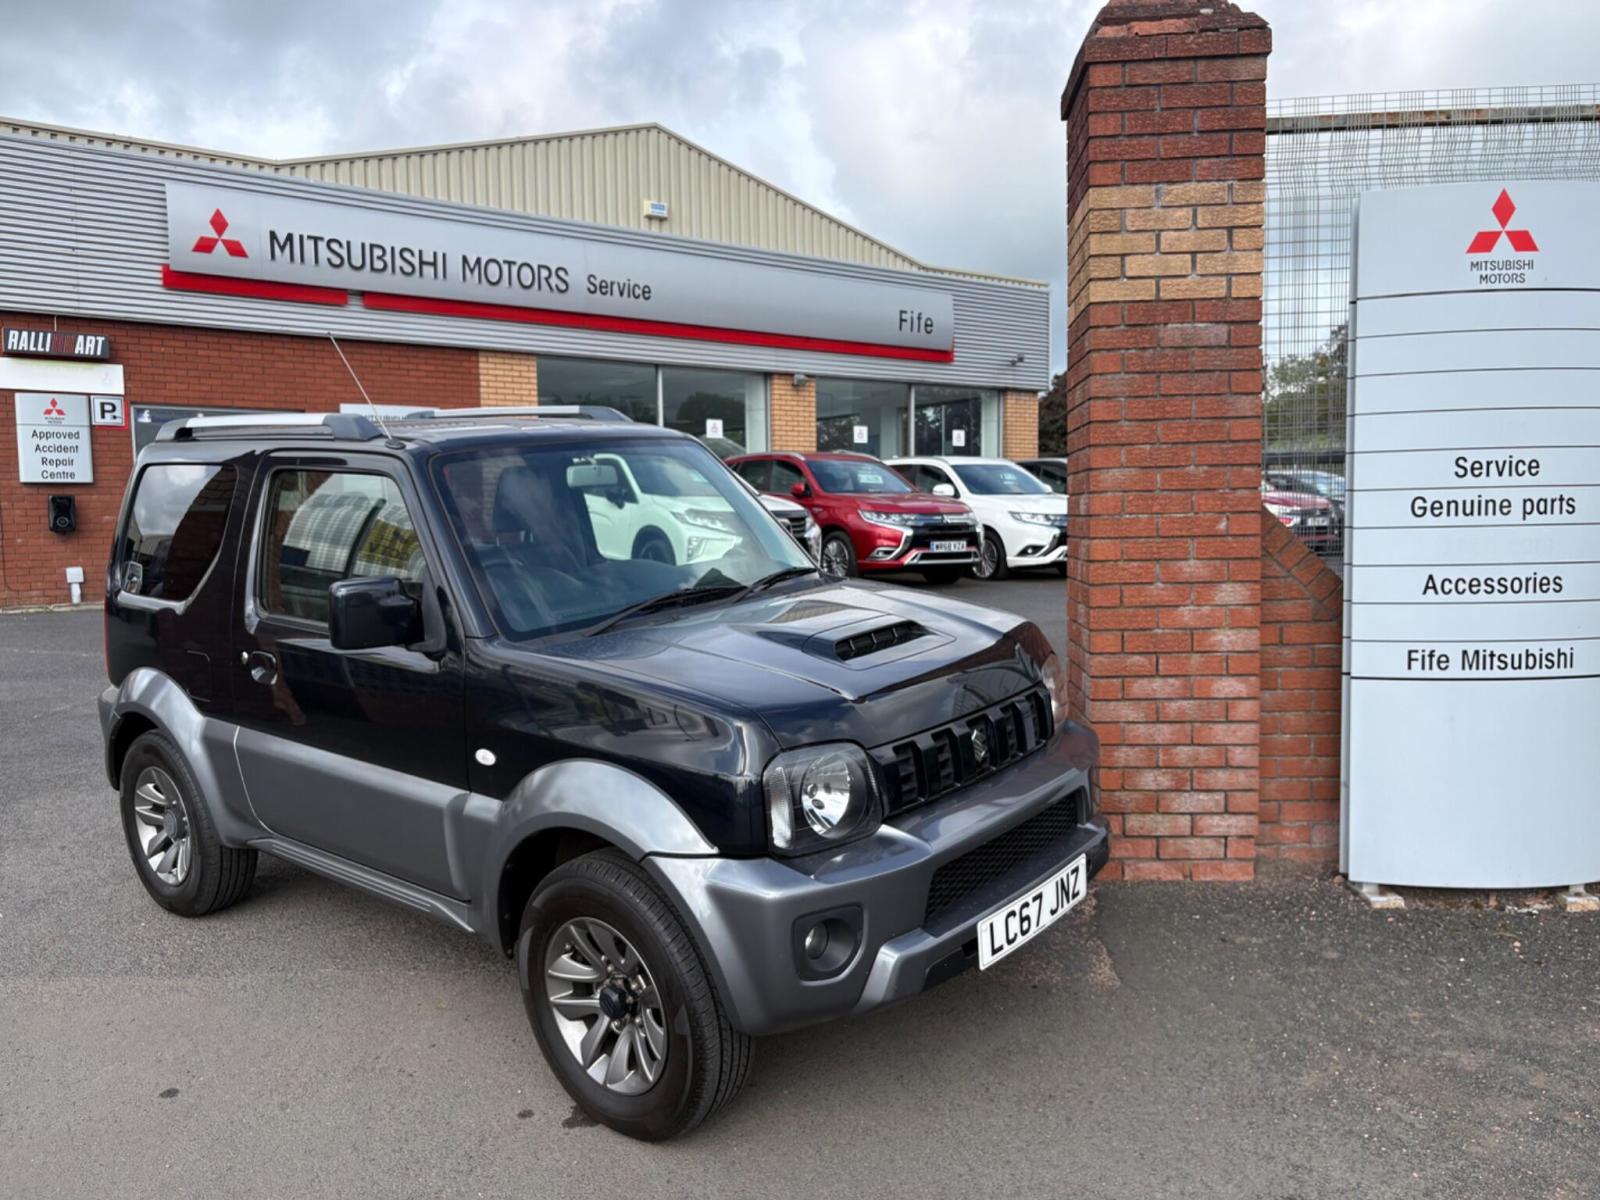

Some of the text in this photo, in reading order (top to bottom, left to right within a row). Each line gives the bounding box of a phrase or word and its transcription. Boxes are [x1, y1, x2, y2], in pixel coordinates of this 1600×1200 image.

[1469, 259, 1534, 272] MITSUBISHI
[268, 229, 934, 335] MITSUBISHI MOTORS Service Fife
[1479, 272, 1526, 285] MOTORS
[100, 401, 116, 420] P
[31, 429, 80, 441] Approved
[35, 443, 79, 453] Accident
[41, 456, 74, 468] Repair
[1454, 455, 1541, 479] Service
[41, 469, 76, 480] Centre
[1410, 494, 1576, 521] Genuine parts
[1422, 572, 1564, 596] Accessories
[1407, 647, 1575, 671] Fife Mitsubishi
[989, 865, 1080, 957] LC67 JNZ
